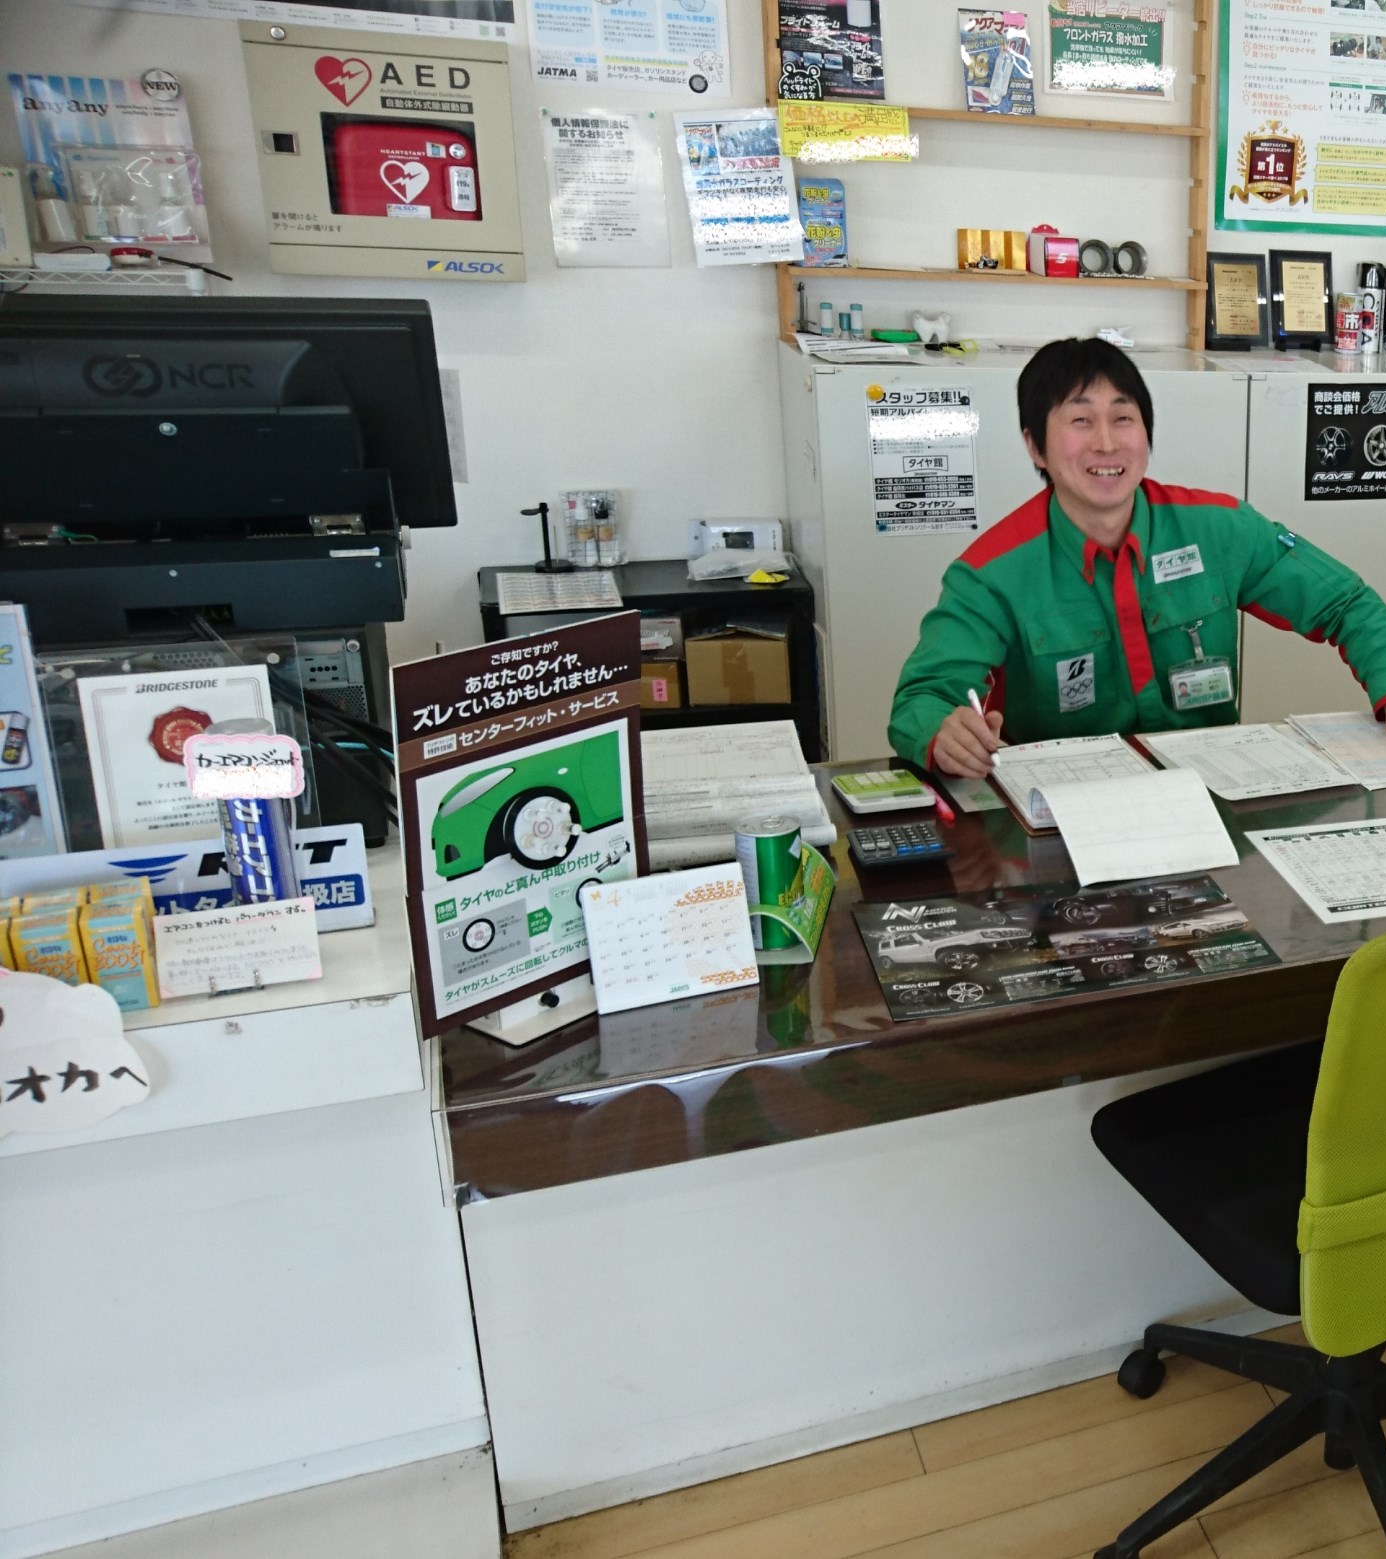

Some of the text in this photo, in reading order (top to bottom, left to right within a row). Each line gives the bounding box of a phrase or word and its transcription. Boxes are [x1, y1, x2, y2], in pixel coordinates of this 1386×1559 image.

[380, 62, 471, 90] AED
[537, 66, 577, 78] JATMA
[146, 80, 179, 92] NEW
[167, 362, 257, 389] NCR
[1314, 391, 1361, 403] 商談会価格
[870, 408, 928, 417] 短期アルバイ
[1314, 405, 1359, 415] でご提供!
[908, 458, 943, 468] タイヤ館
[1312, 471, 1355, 481] RAYS
[491, 641, 559, 666] ご存知ですか?
[465, 653, 583, 694] あなたのタイヤ、
[135, 679, 218, 694] BRIDGESTONE
[413, 665, 628, 732] ズレているかもしれません…
[459, 691, 620, 748] センターフィット・サービス
[460, 851, 601, 911] タイヤのど真ん中取り付け
[886, 924, 922, 933] CROSS
[0, 1060, 148, 1103] オカへ
